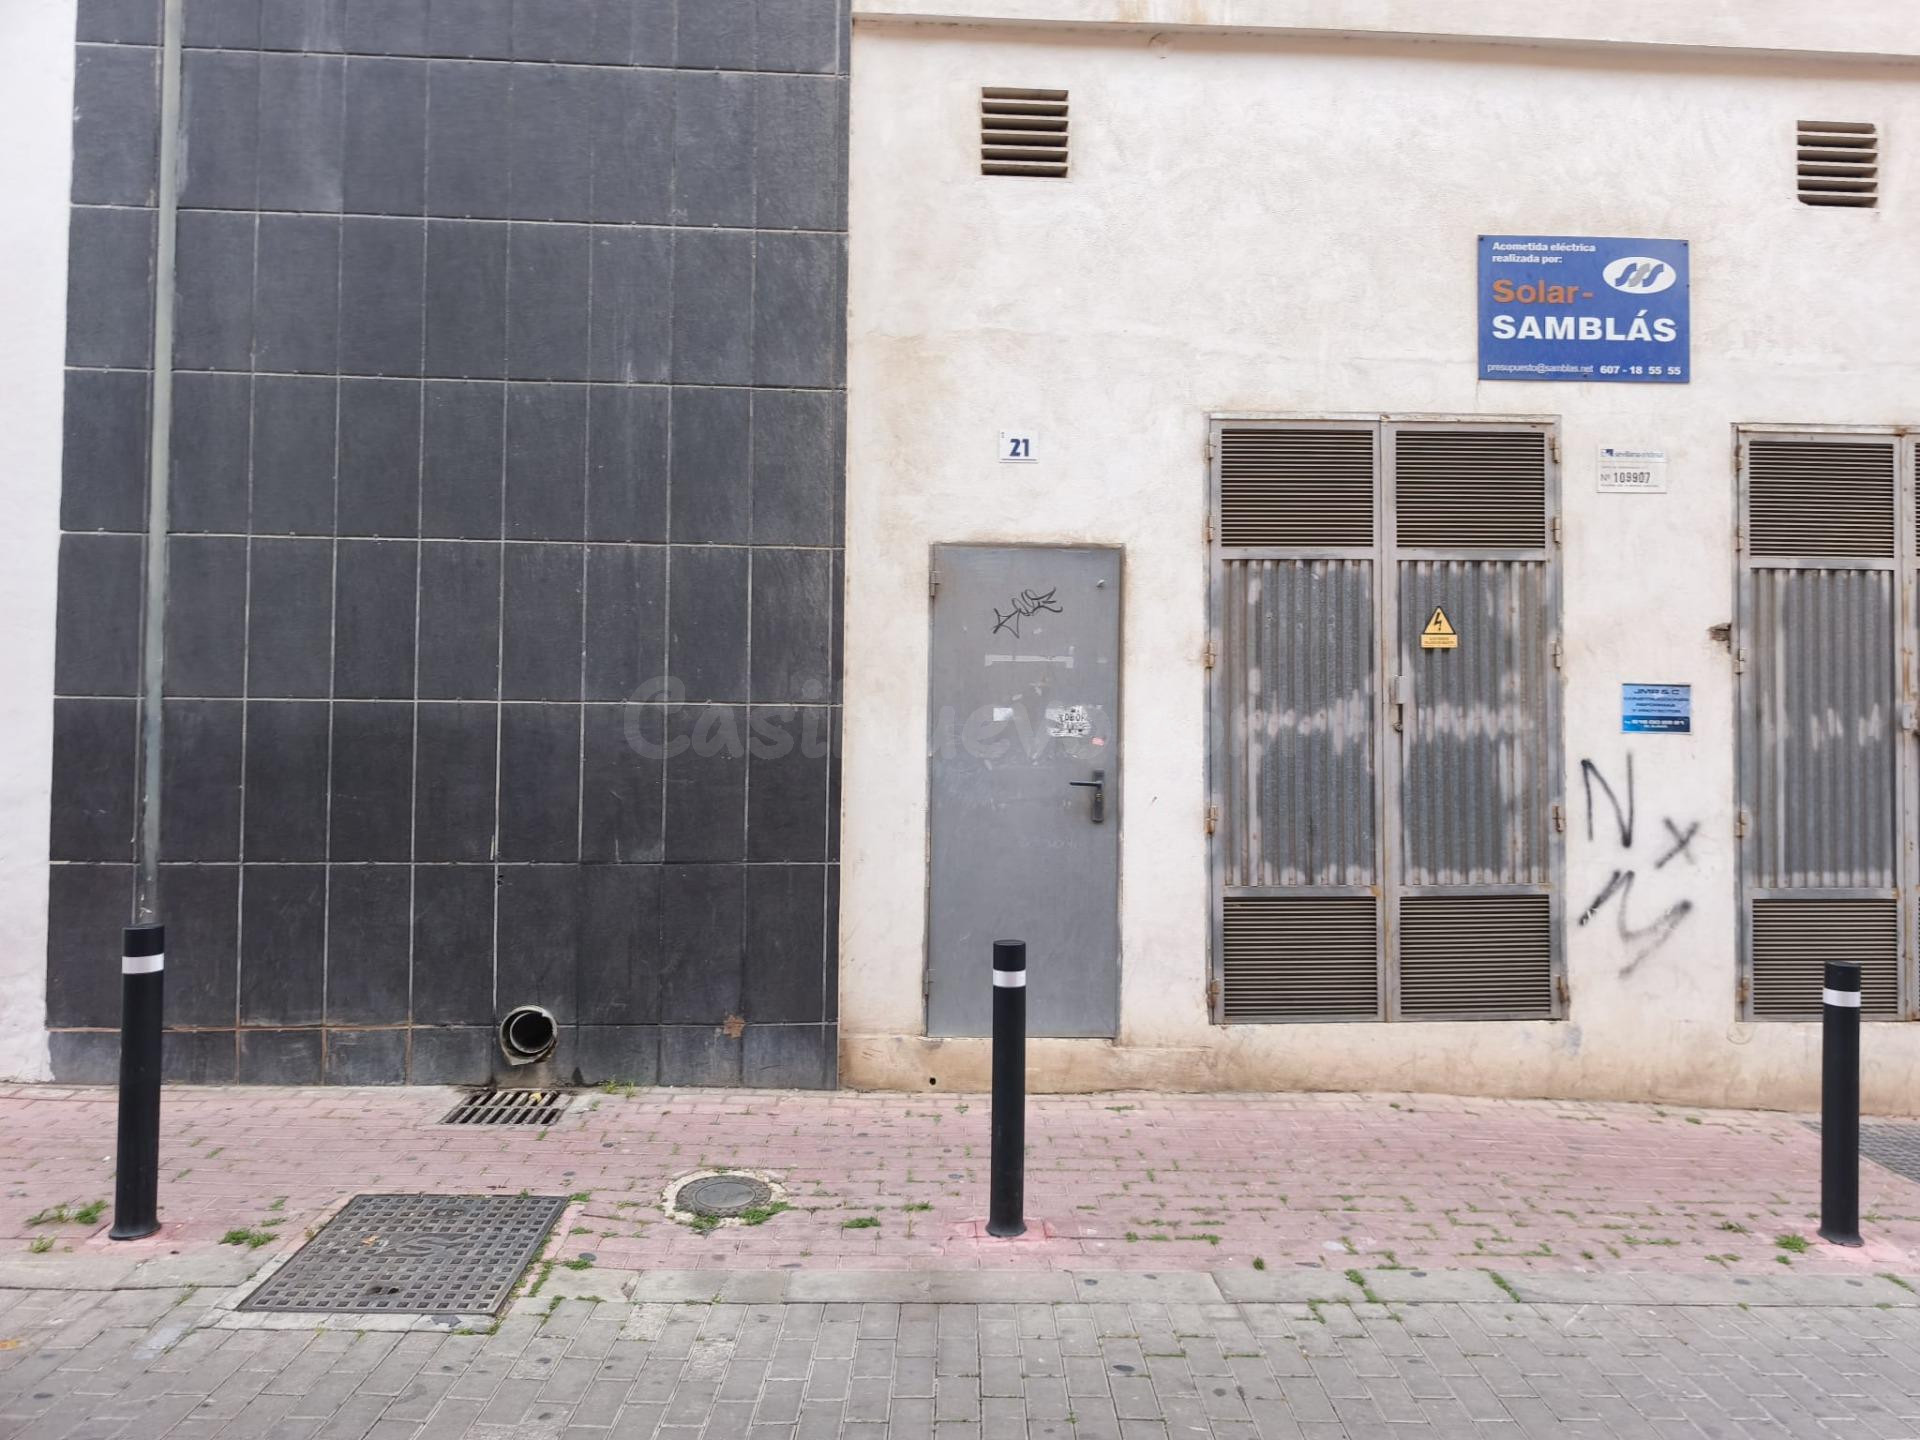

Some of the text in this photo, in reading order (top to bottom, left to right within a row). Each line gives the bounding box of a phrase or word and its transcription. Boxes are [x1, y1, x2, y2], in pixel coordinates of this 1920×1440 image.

[1492, 241, 1596, 253] Acometida eléctrica
[1492, 254, 1563, 265] realizada por:
[1492, 309, 1677, 342] SAMBLÁS
[1599, 365, 1619, 375] 607
[1630, 365, 1643, 375] 18
[1648, 365, 1662, 375] 55
[1667, 366, 1681, 375] 55
[1009, 438, 1030, 457] 21
